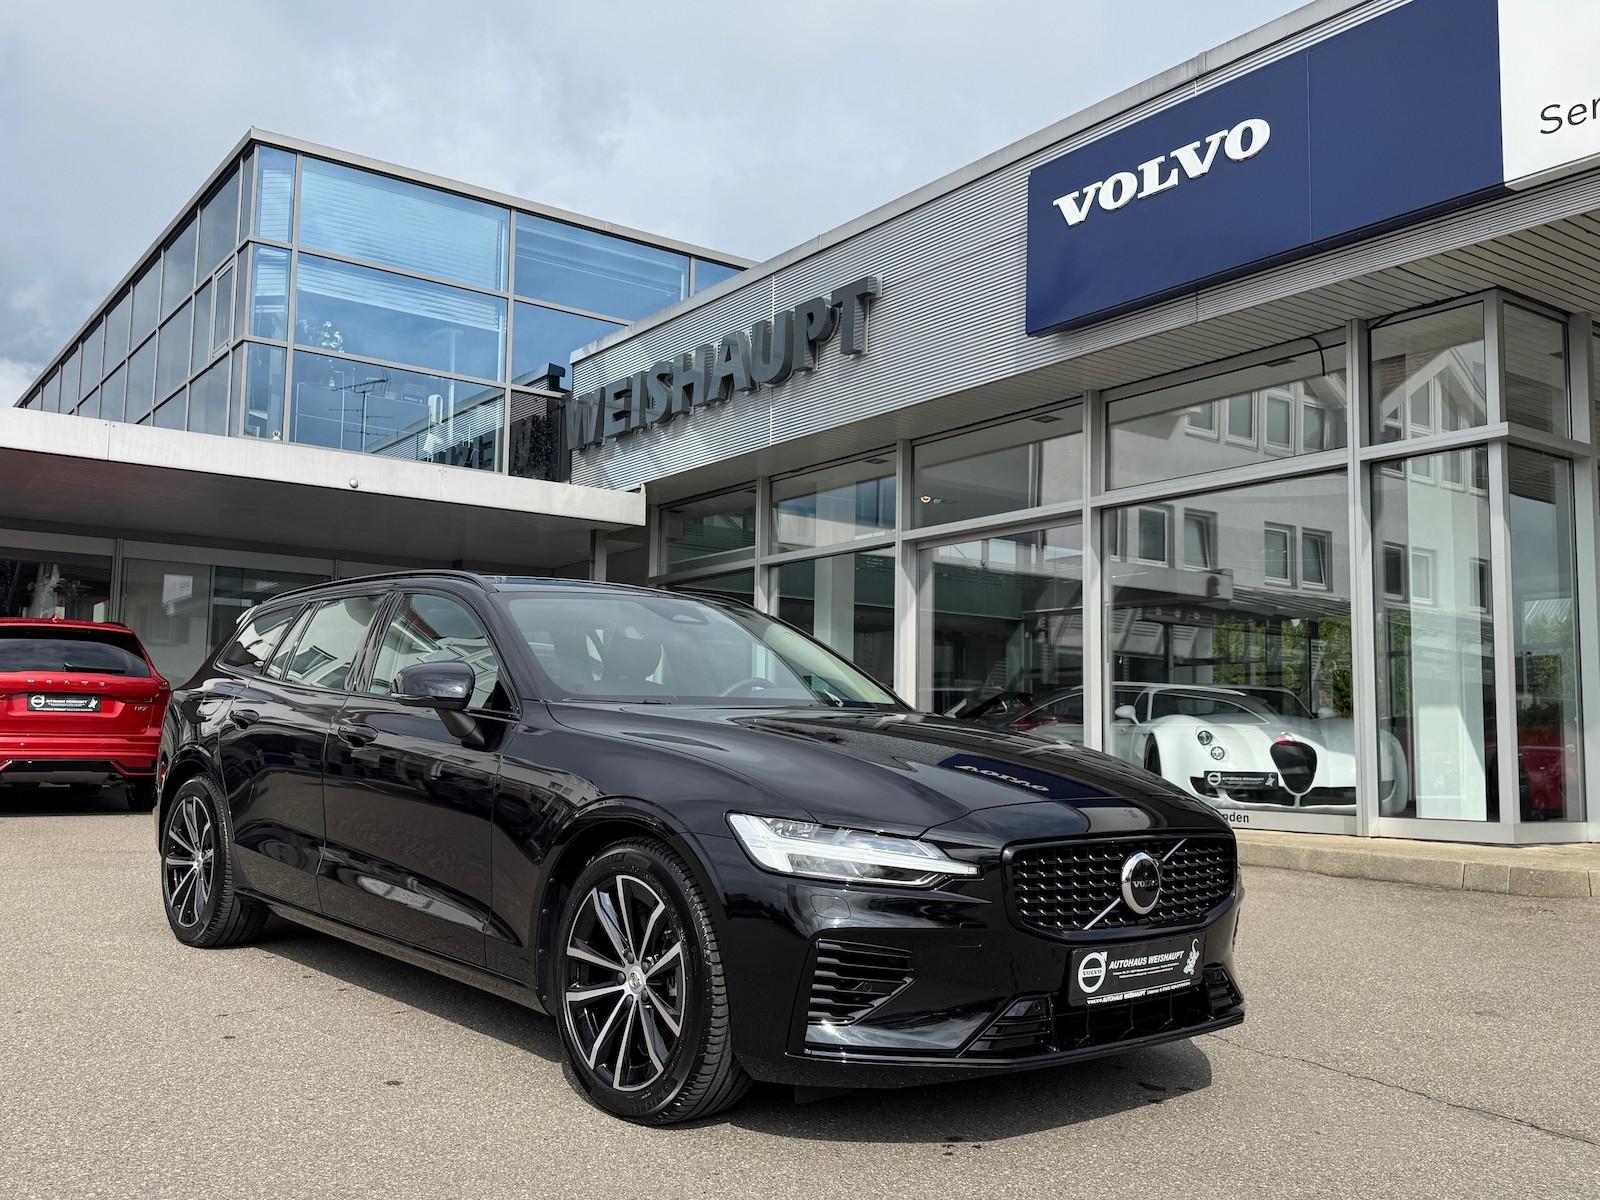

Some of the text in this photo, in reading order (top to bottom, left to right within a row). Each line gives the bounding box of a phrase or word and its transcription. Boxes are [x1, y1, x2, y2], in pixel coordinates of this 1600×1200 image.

[1053, 118, 1271, 226] VOLVO
[565, 275, 883, 451] WEISHAUPT
[1109, 957, 1147, 970] AUTOHAUS
[1148, 950, 1185, 964] WEISHAUPT
